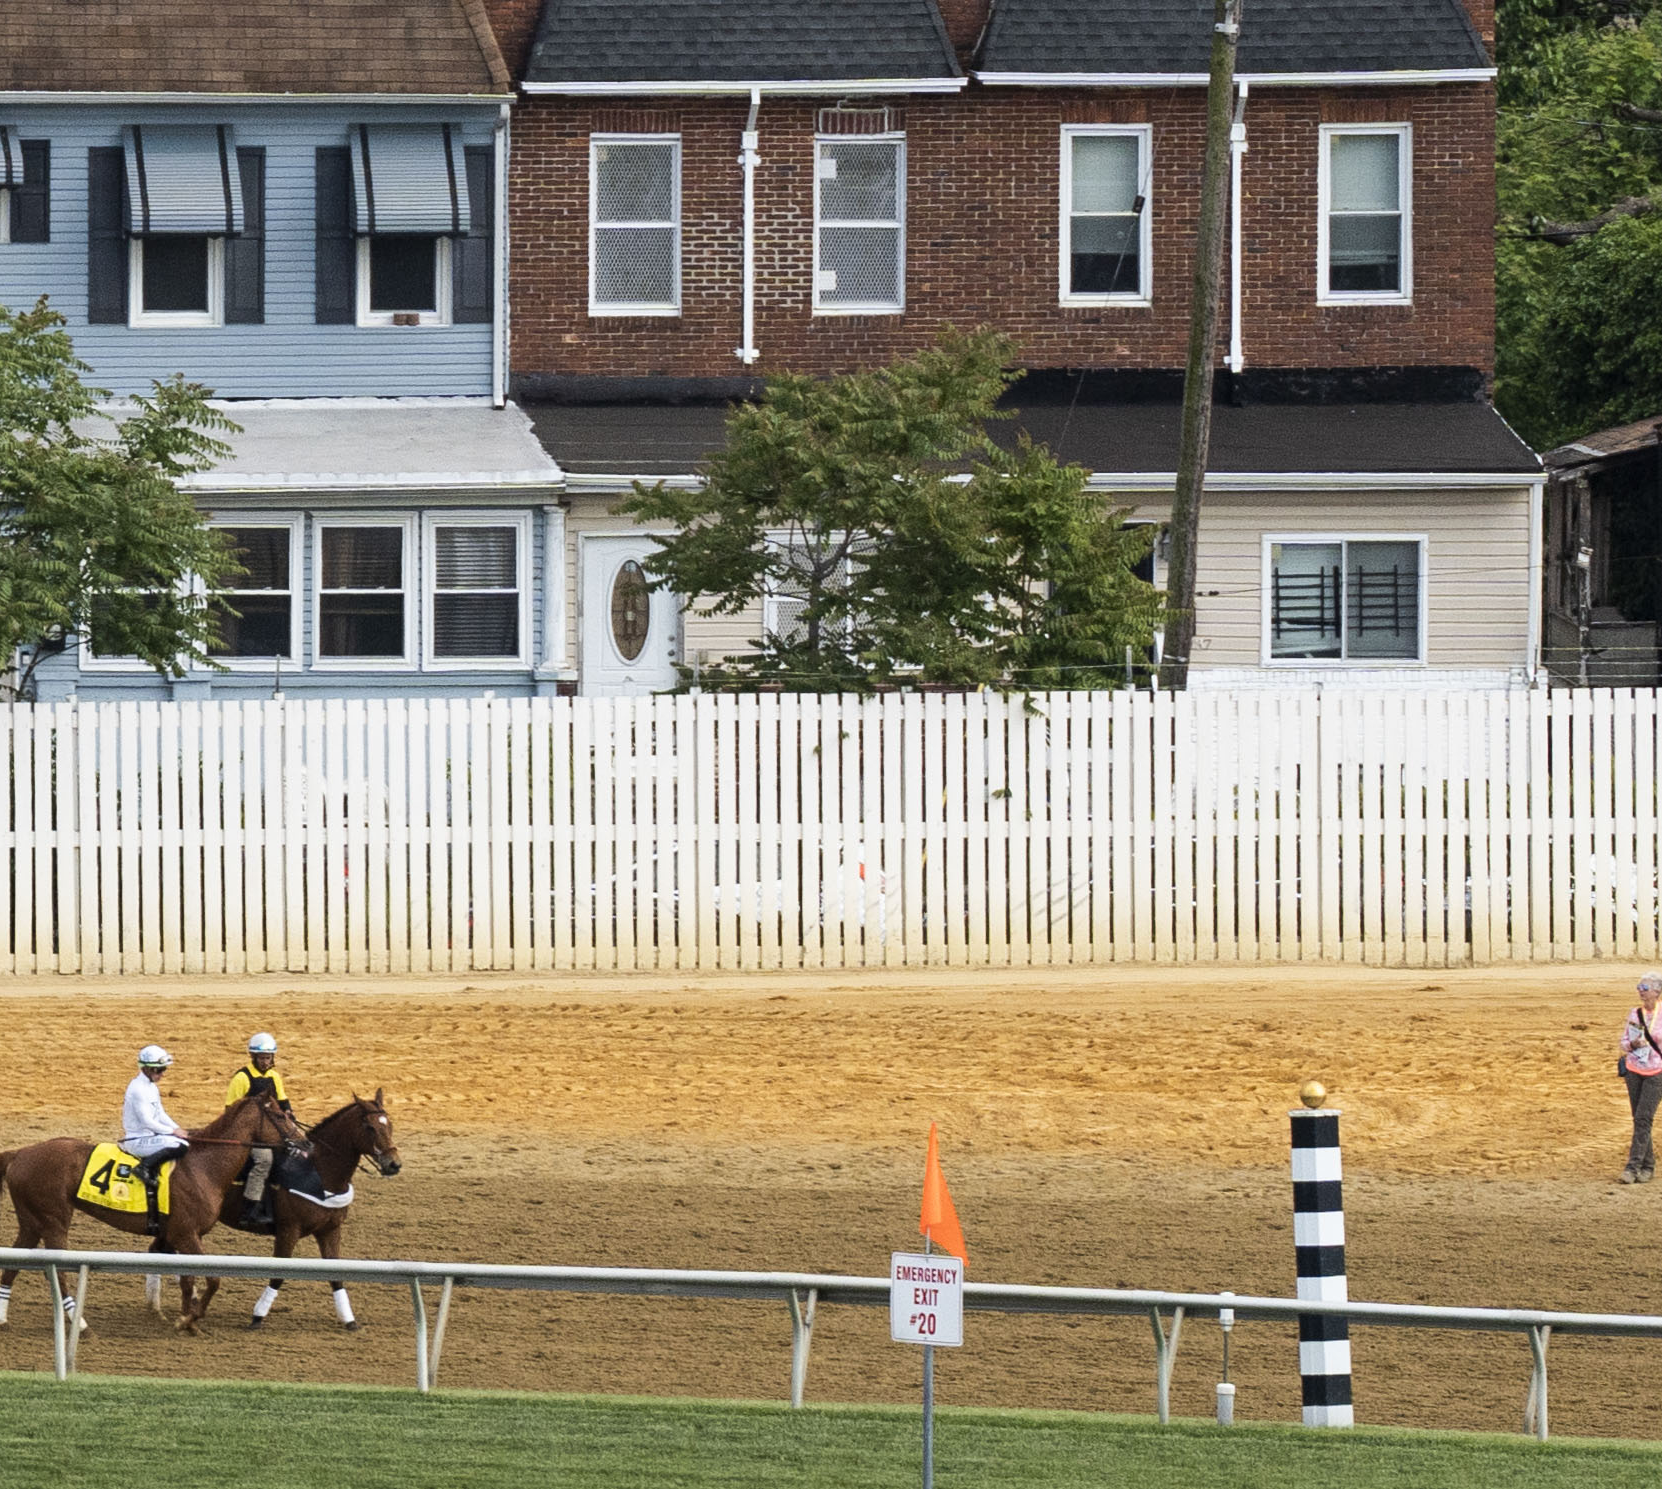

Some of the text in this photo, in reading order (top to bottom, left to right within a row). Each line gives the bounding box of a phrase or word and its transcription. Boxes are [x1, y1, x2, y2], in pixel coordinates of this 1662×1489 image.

[89, 1158, 116, 1195] 4
[895, 1264, 958, 1285] EMERGENCY
[913, 1286, 940, 1307] EXIT
[909, 1311, 937, 1336] #20
